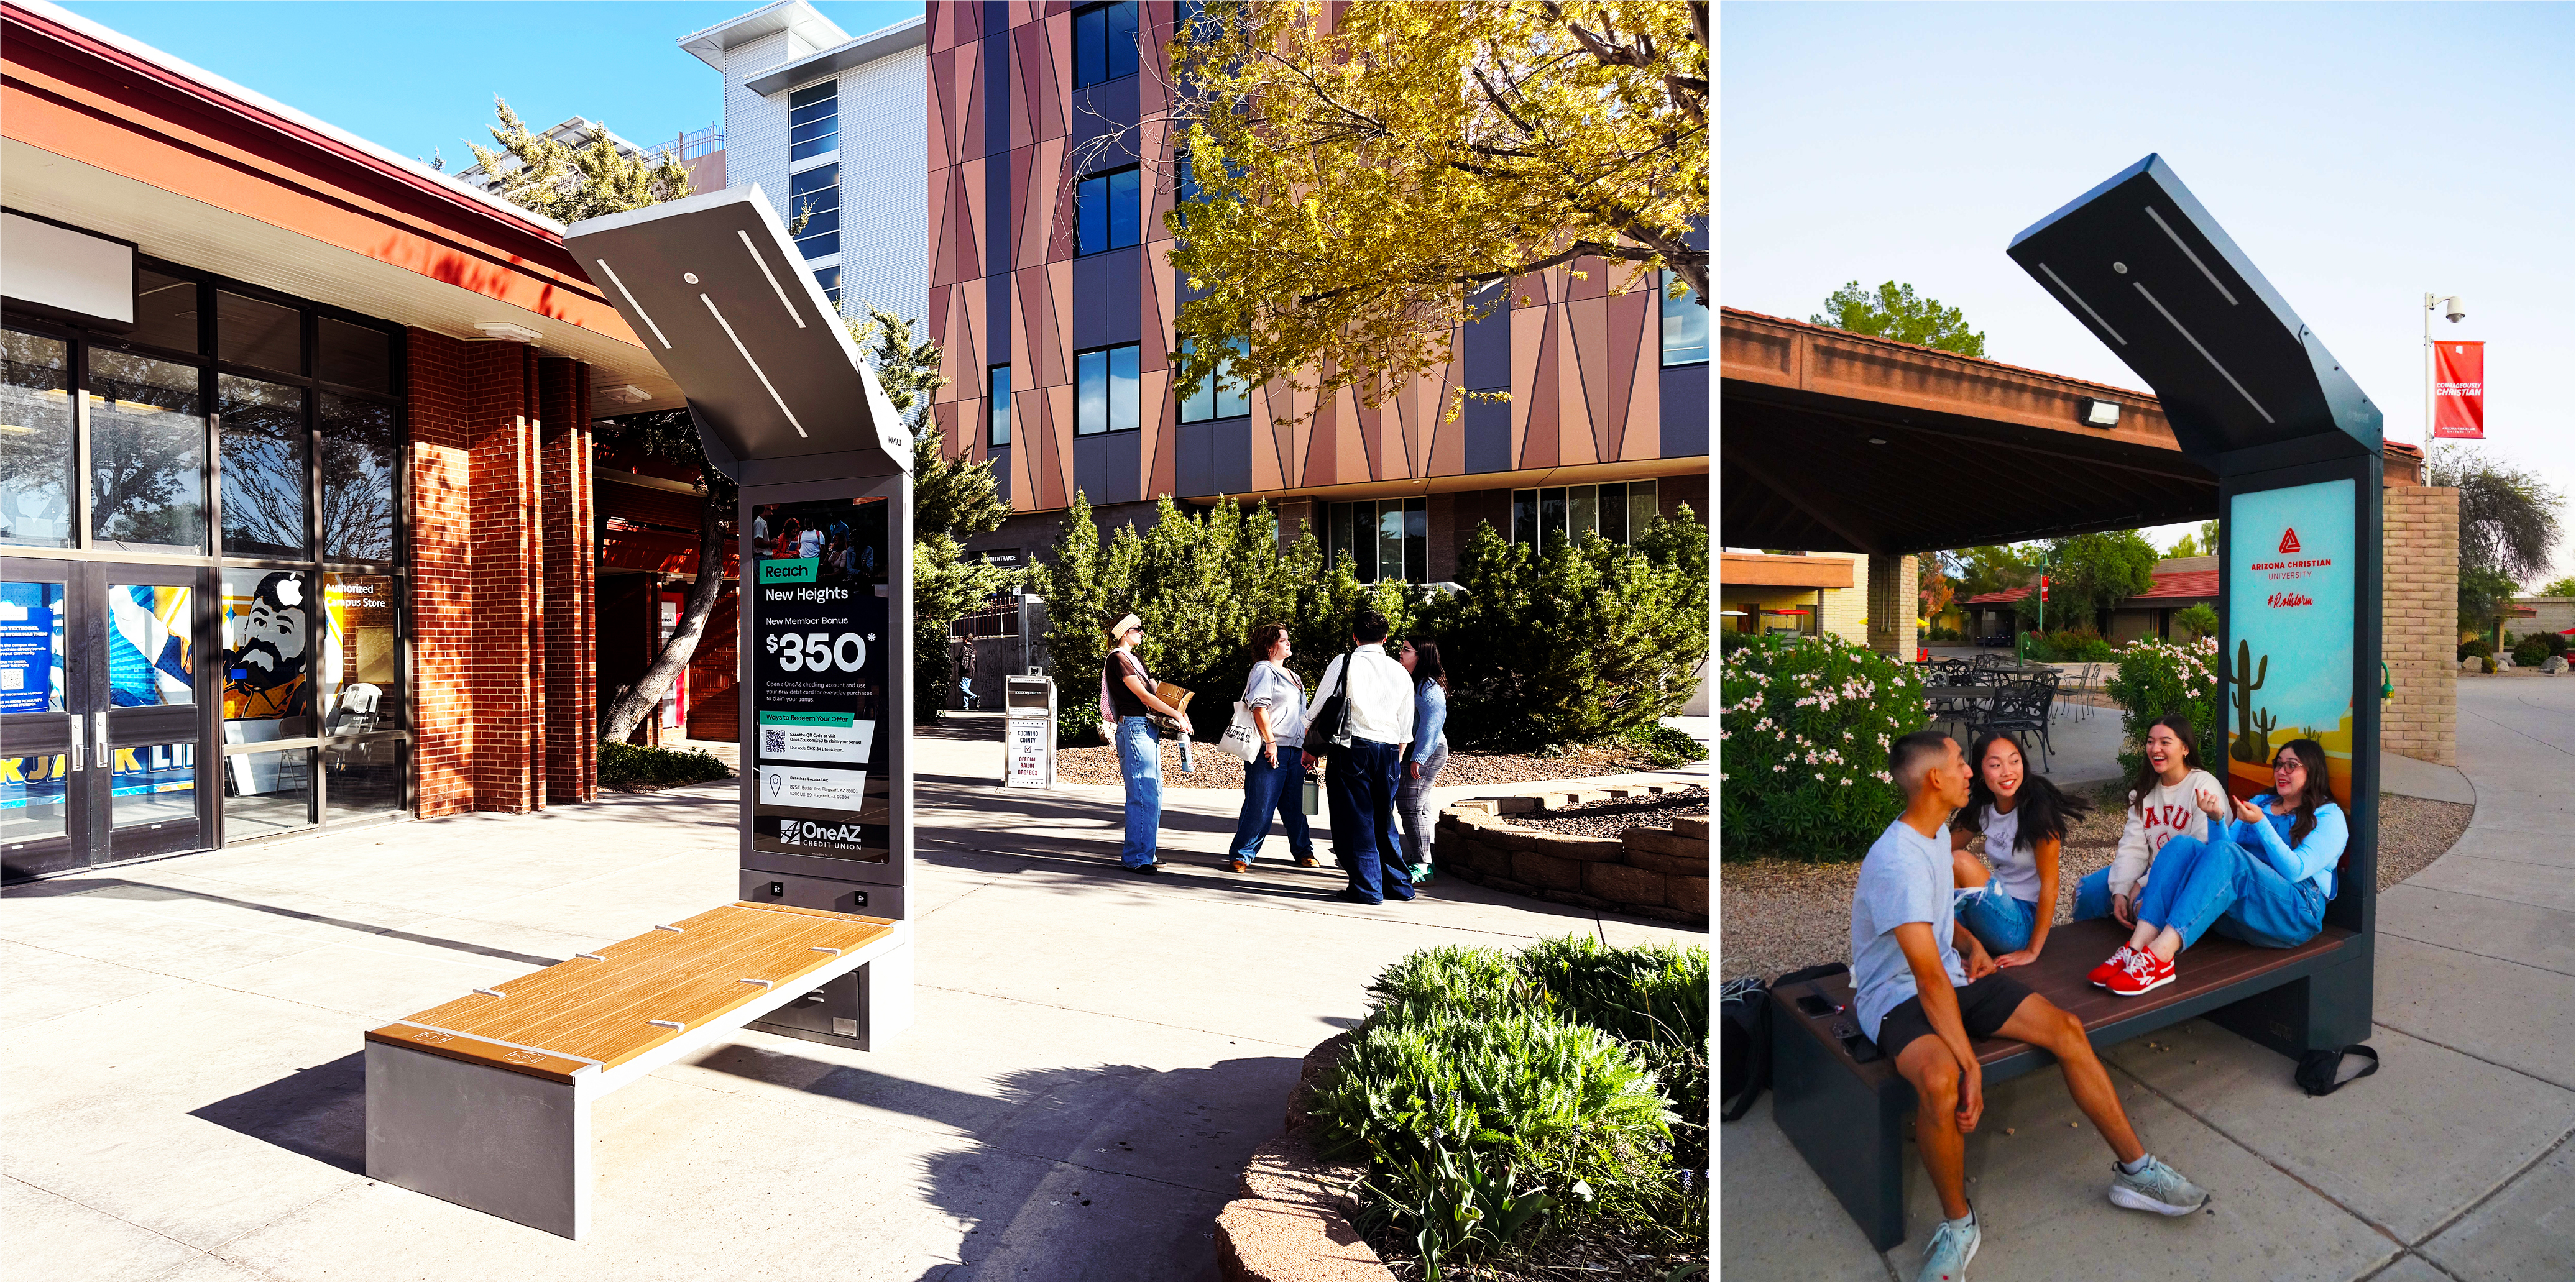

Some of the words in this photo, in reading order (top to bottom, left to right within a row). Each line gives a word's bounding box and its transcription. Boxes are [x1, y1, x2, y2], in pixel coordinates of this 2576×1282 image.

[2252, 562, 2284, 570] ARIZONA
[2288, 559, 2331, 568] CHRISTIAN
[766, 565, 808, 577] Reach
[2269, 571, 2312, 580] UNIVERSITY
[326, 583, 374, 593] Authorized
[766, 589, 794, 601] New
[798, 587, 849, 603] Heights
[2268, 592, 2314, 608] #Rollstorm
[325, 597, 361, 608] Campus
[363, 598, 385, 607] Store
[2145, 804, 2192, 831] ACU
[802, 822, 862, 843] OneAZ
[803, 840, 831, 848] CREDIT
